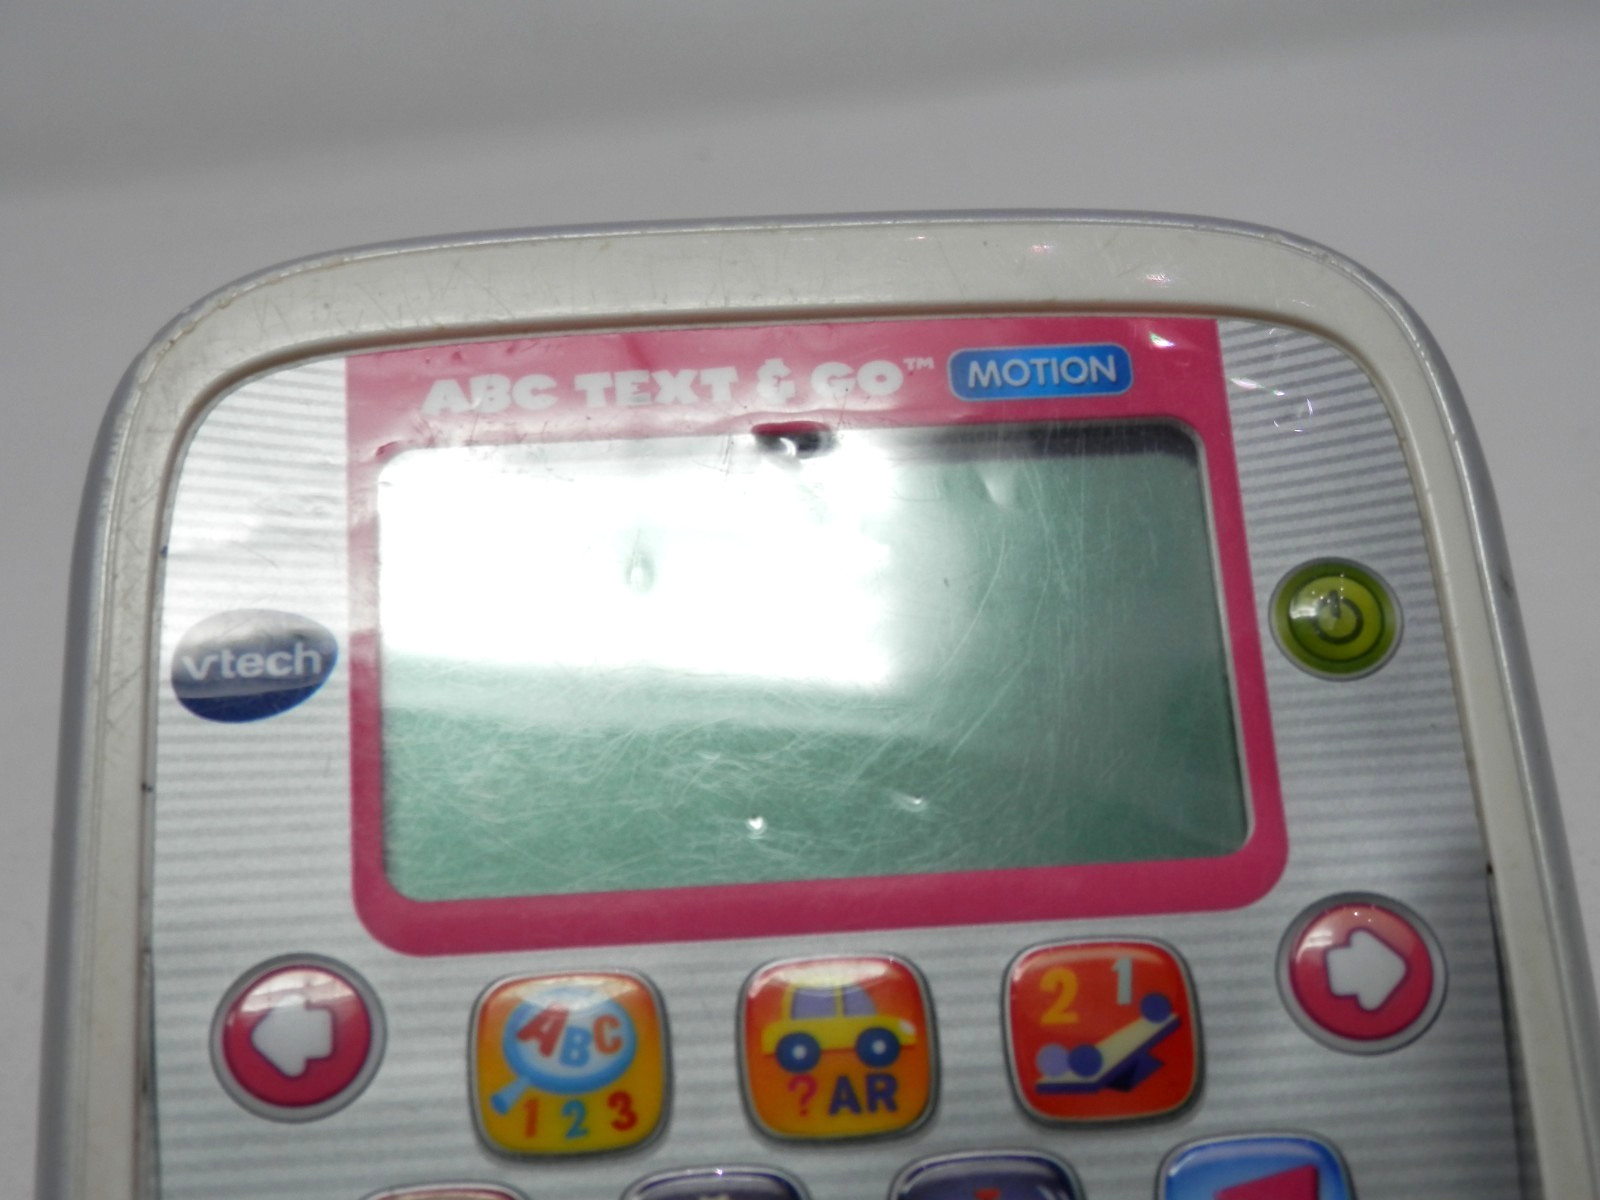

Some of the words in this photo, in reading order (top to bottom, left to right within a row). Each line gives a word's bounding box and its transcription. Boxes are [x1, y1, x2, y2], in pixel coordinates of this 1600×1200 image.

[423, 373, 558, 415] ABC
[575, 367, 740, 409] TEXT
[756, 358, 796, 400] &
[967, 354, 1119, 389] MOTION
[182, 642, 323, 680] vtech
[1039, 967, 1079, 1026] 2
[1110, 956, 1133, 1006] 1
[516, 1005, 623, 1068] ABC
